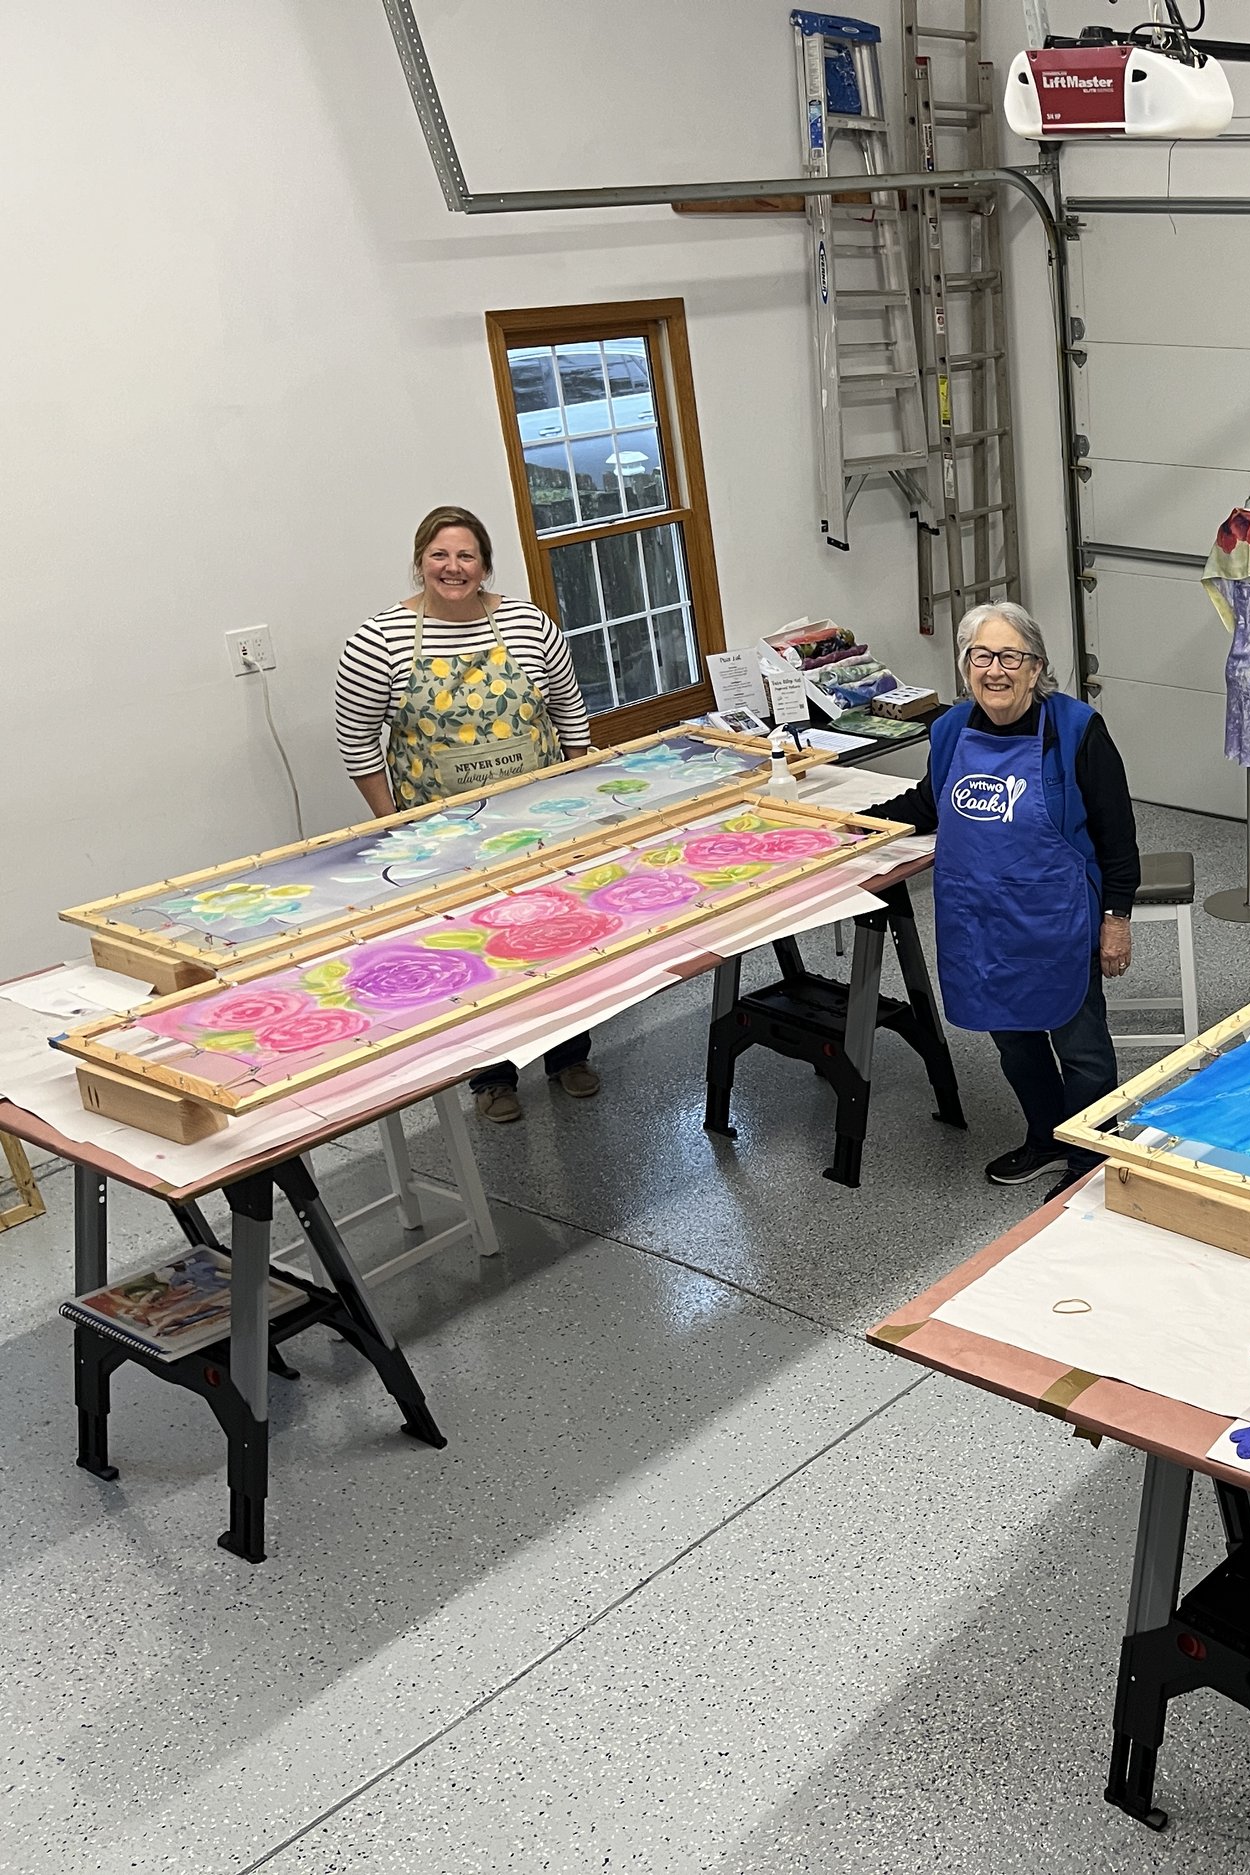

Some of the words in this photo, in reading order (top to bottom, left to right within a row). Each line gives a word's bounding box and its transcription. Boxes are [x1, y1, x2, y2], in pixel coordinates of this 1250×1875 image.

[1042, 75, 1114, 89] LiftMaster
[455, 759, 493, 773] NEVER
[494, 752, 523, 766] SOUR
[457, 770, 494, 787] always
[499, 762, 524, 777] sweet
[955, 788, 1007, 814] Cooks
